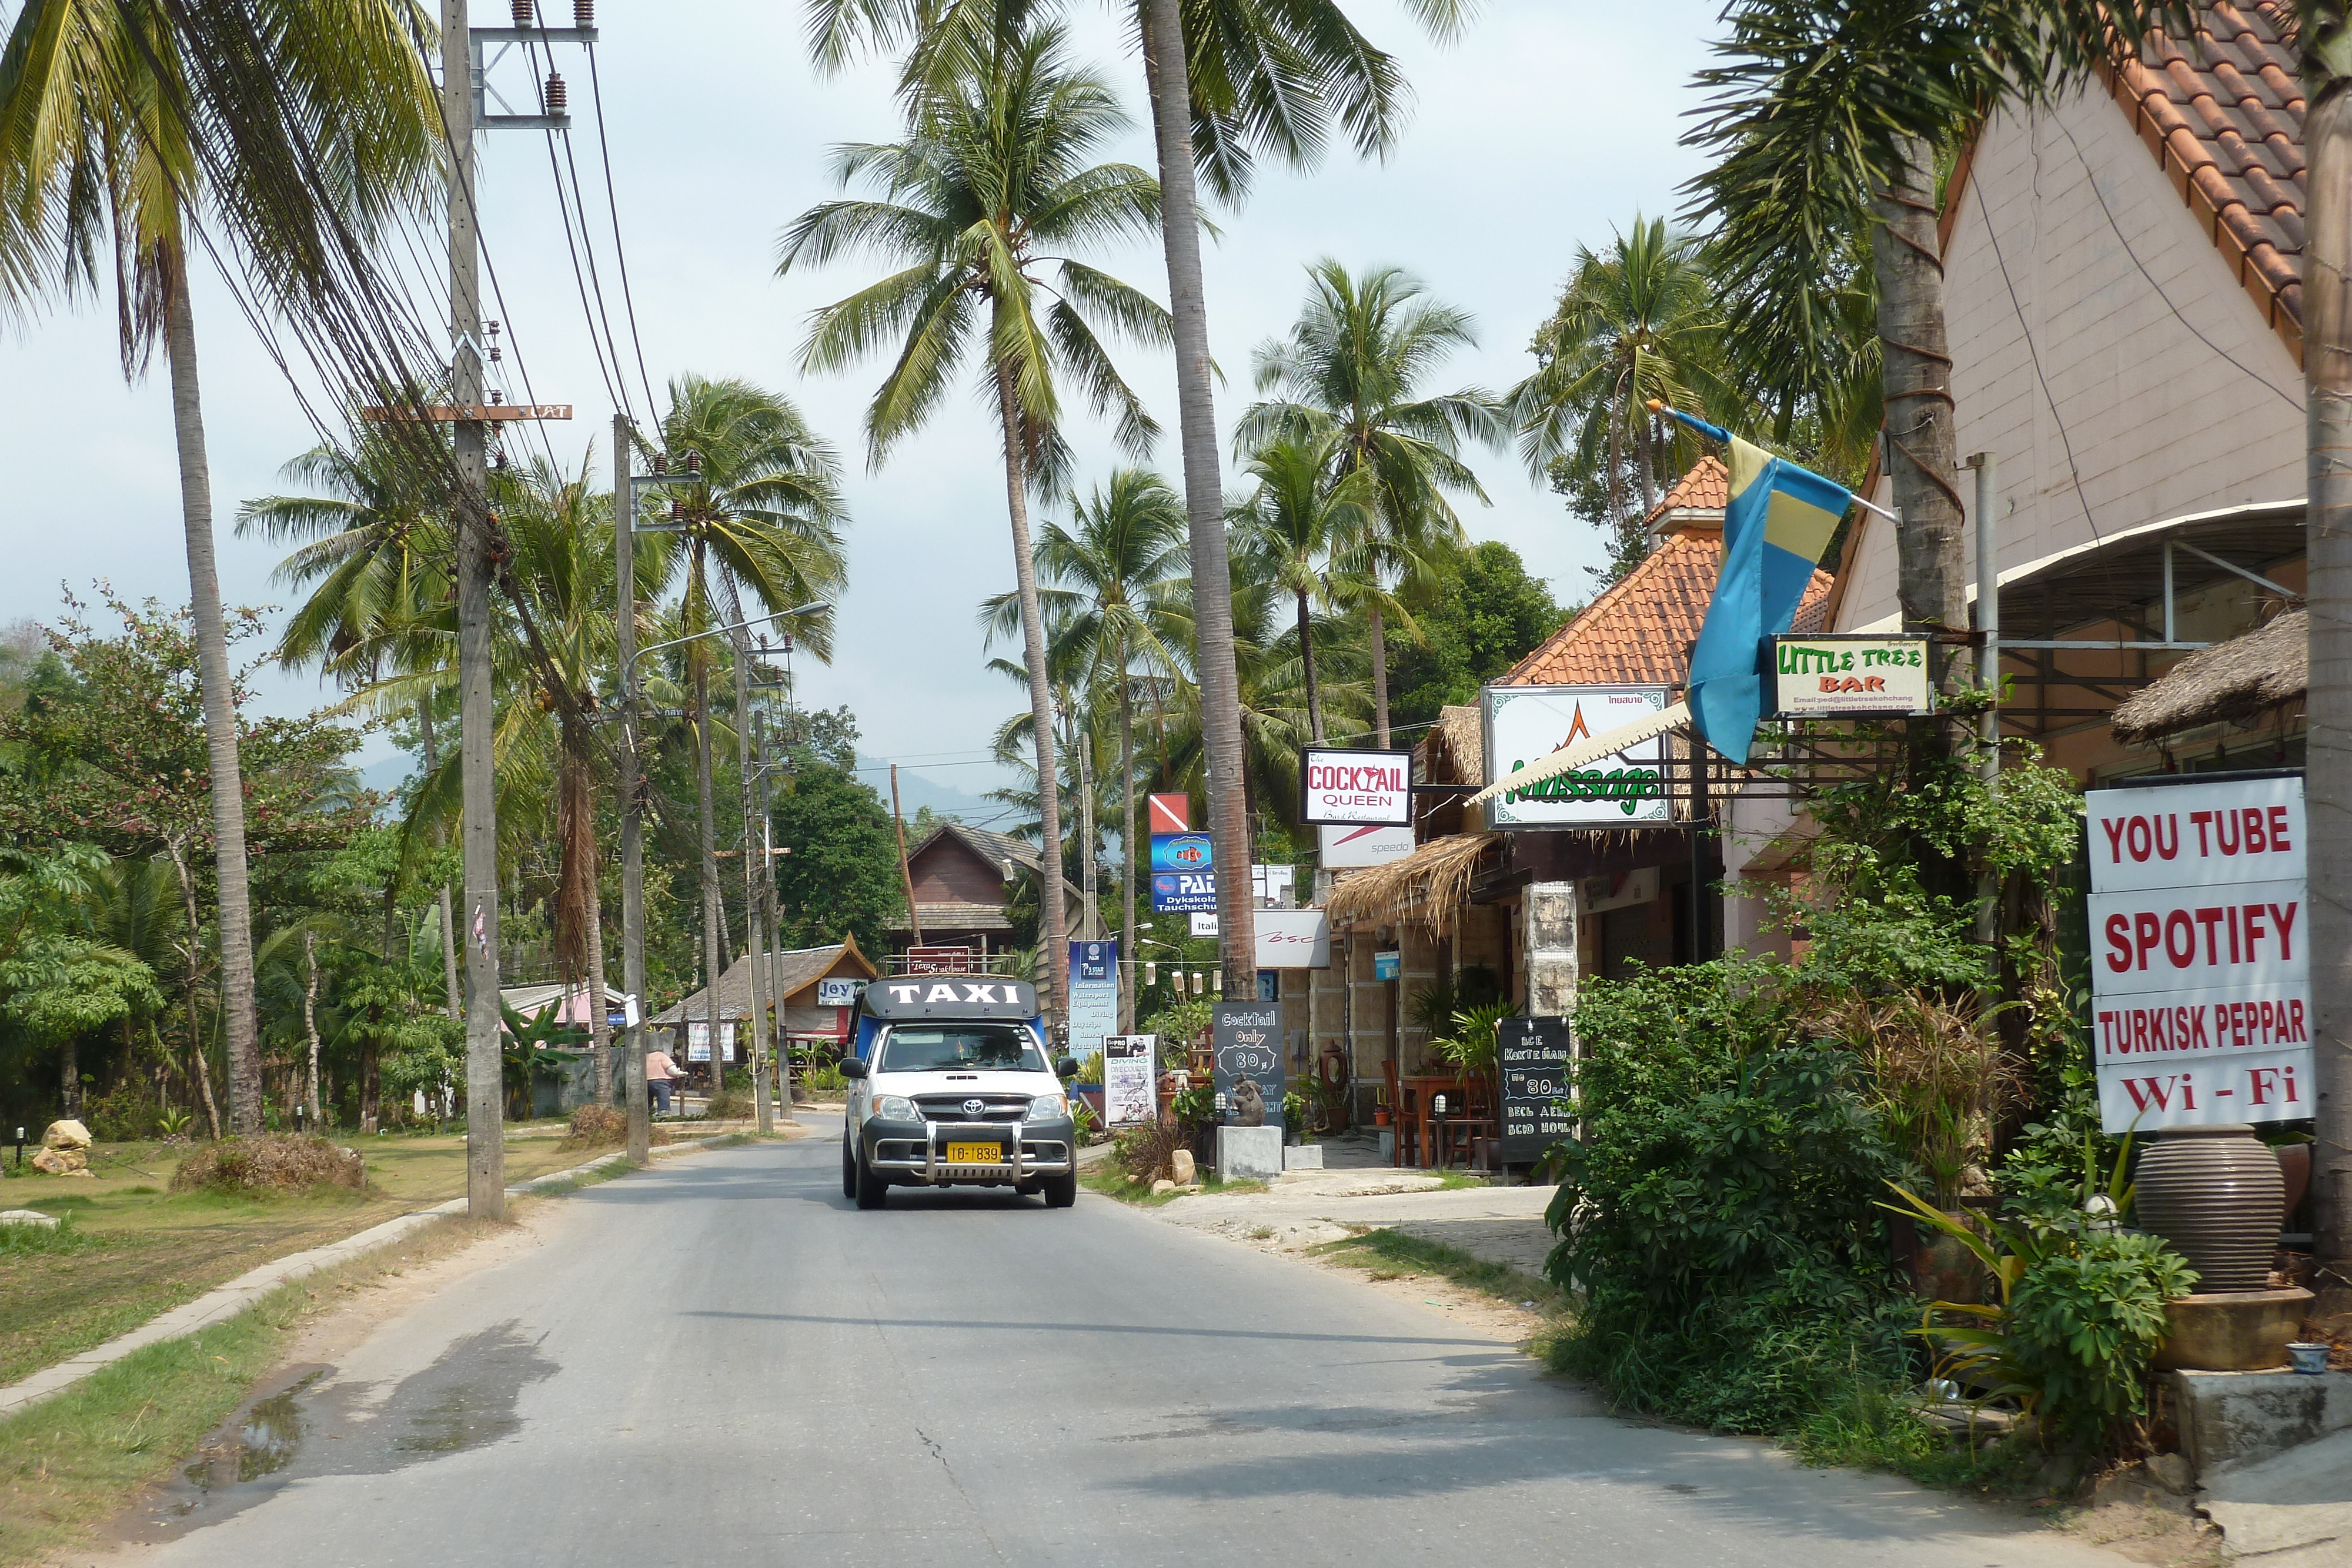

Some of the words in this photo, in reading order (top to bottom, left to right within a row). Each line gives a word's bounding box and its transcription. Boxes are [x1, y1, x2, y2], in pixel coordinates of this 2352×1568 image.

[530, 406, 567, 417] CAT
[1779, 644, 1854, 674] LITTLE
[1862, 648, 1922, 668] TREE
[1818, 676, 1885, 694] BAR
[1608, 696, 1642, 704] ไทยสบาย
[1310, 754, 1324, 763] The
[1309, 765, 1406, 792] COCKTAIL
[1323, 794, 1392, 807] QUEEN
[1348, 811, 1390, 821] Restaurant
[2102, 814, 2179, 864] YOU
[2190, 805, 2291, 857] TUBE
[1372, 842, 1409, 854] speedo
[1198, 922, 1219, 930] Itali
[2104, 902, 2297, 973] SPOTIFY
[888, 984, 1021, 1004] TAXI
[1073, 991, 1110, 999] Watersport
[1073, 1000, 1108, 1008] Equipment
[1222, 1010, 1275, 1027] Cocktail
[2099, 1005, 2209, 1054] TURKISK
[2215, 999, 2307, 1047] PEPPAR
[1236, 1029, 1266, 1046] Only
[1521, 1035, 1543, 1046] ВСЕ
[1236, 1052, 1258, 1068] 80
[1260, 1084, 1277, 1095] AY
[1527, 1079, 1552, 1094] 80
[2120, 1074, 2198, 1112] Wi
[2246, 1065, 2300, 1105] Fi
[1508, 1106, 1534, 1117] ВЕСЬ
[1508, 1124, 1534, 1135] ВСЮ
[1541, 1122, 1571, 1134] НОЧЬ
